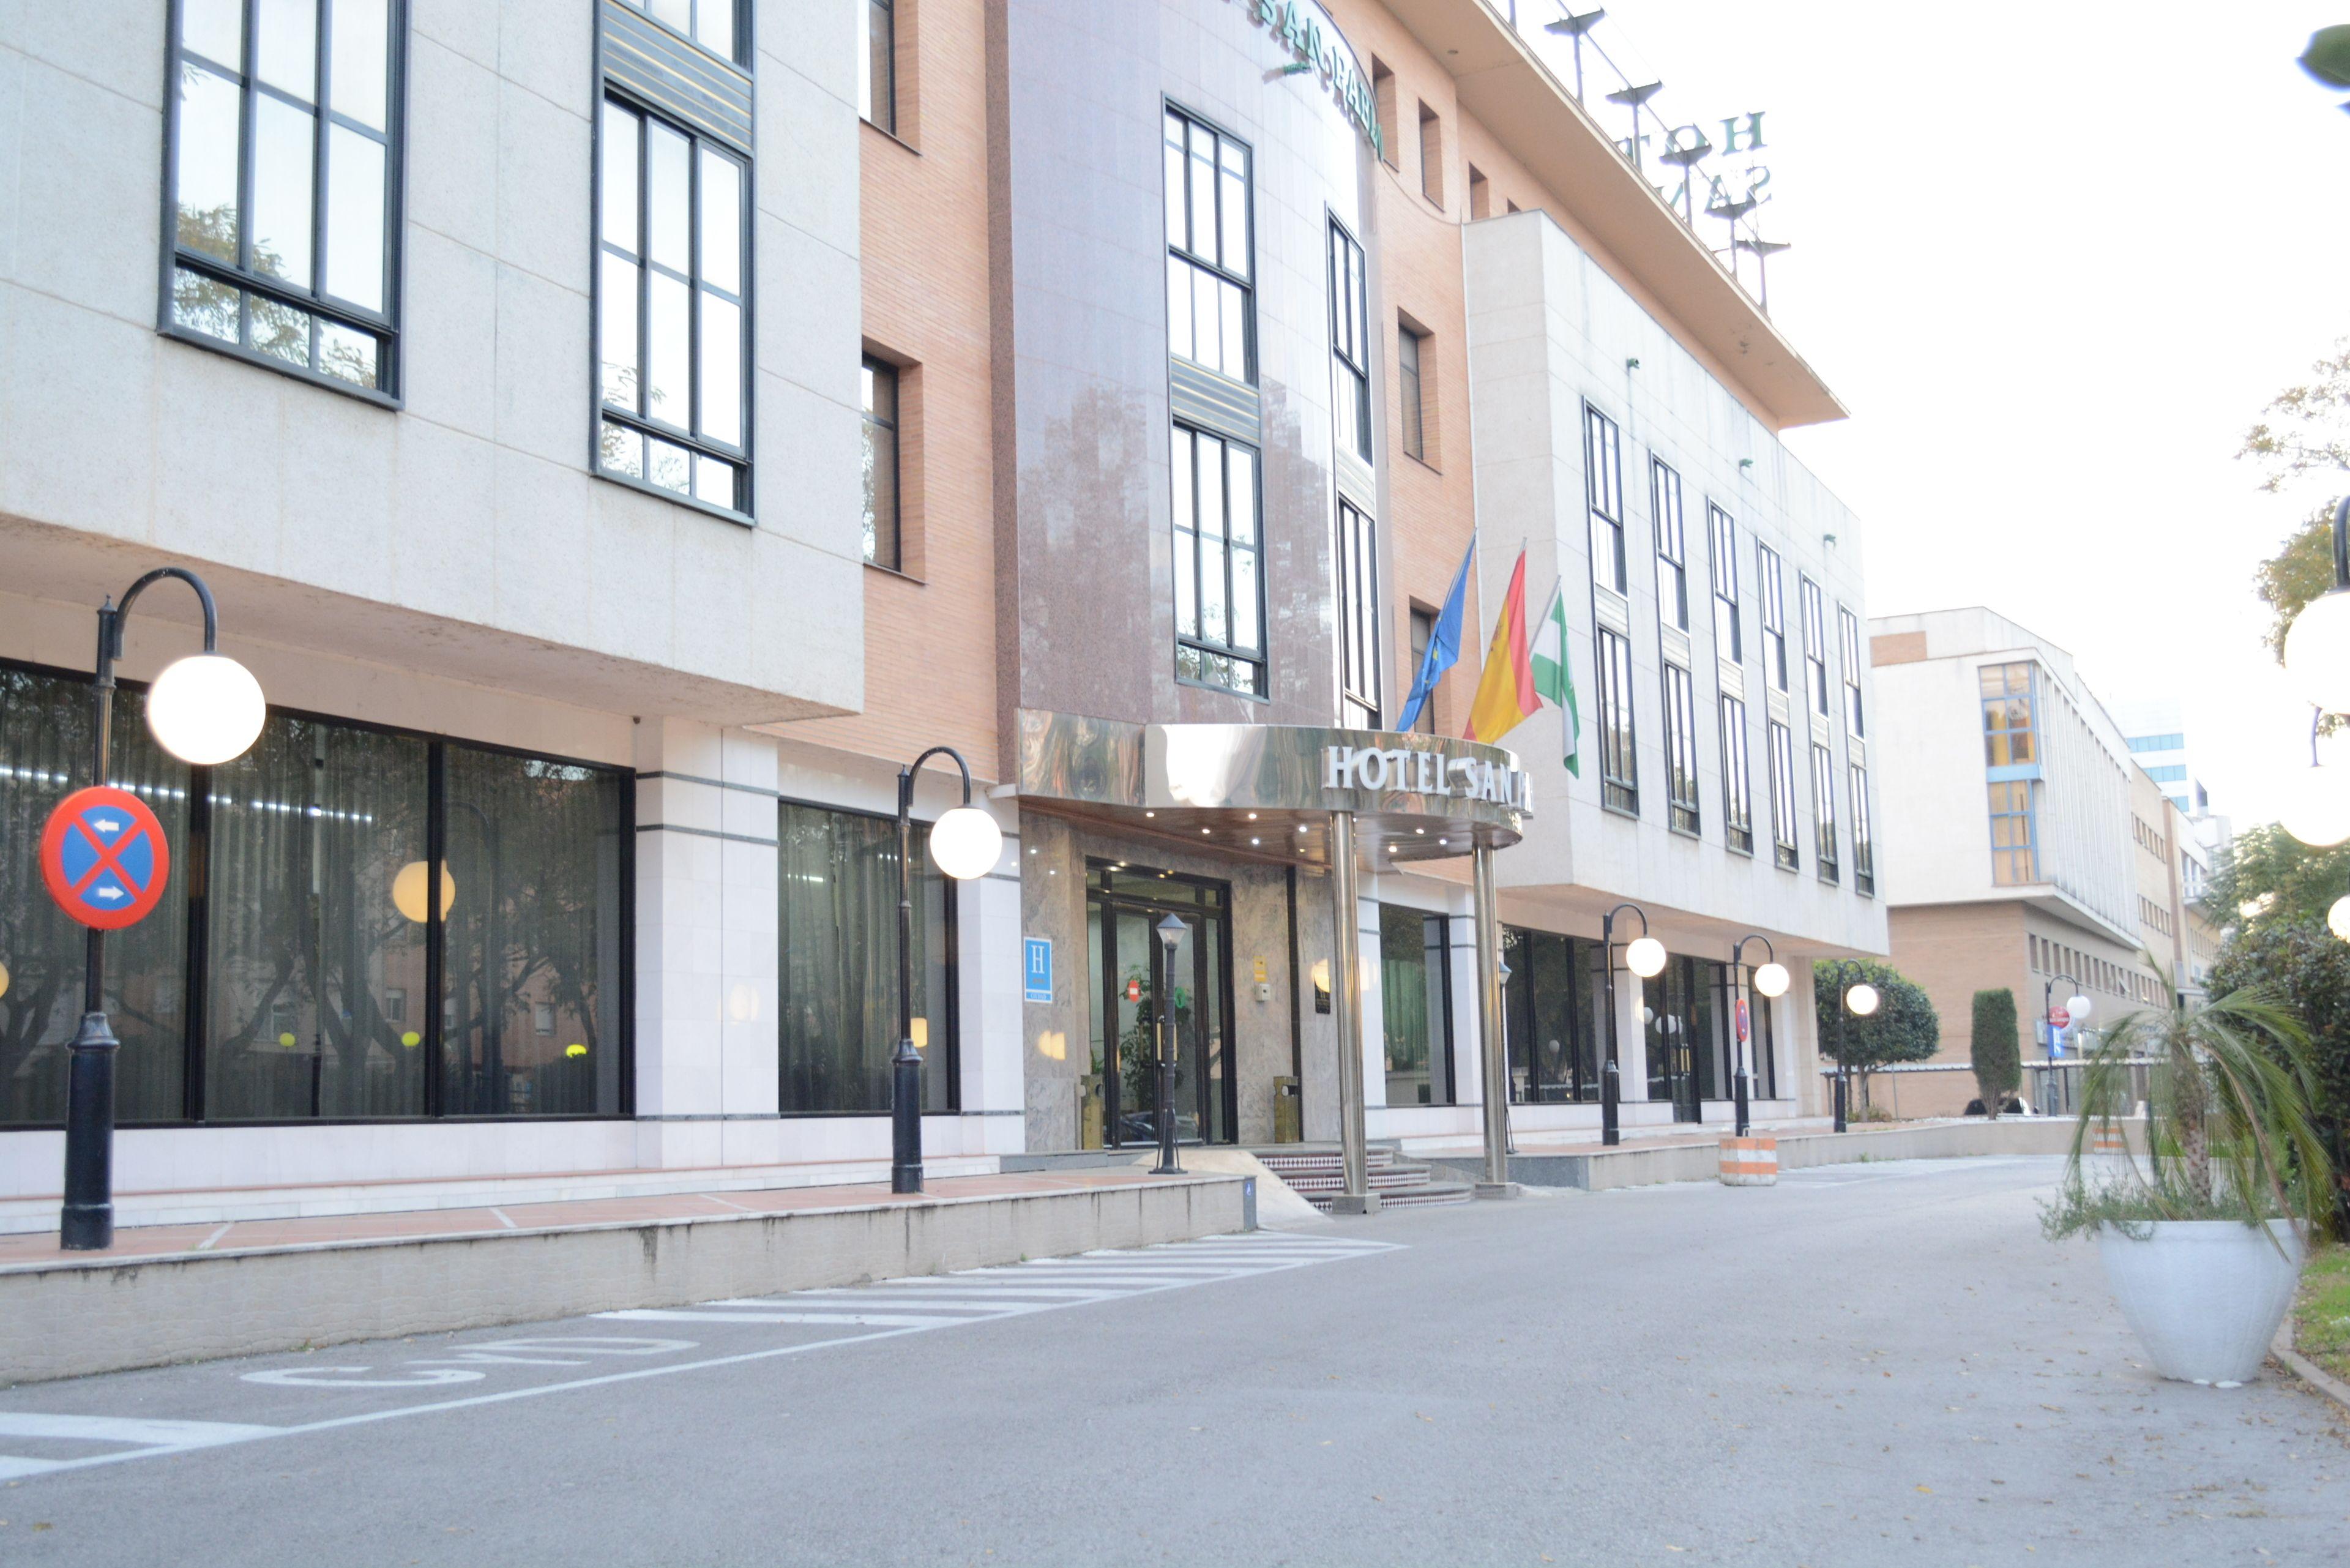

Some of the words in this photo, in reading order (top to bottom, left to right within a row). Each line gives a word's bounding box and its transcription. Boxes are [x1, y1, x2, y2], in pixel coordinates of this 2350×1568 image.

[1327, 745, 1451, 795] HOTEL
[1463, 756, 1512, 805] SAN
[1031, 944, 1045, 974] H
